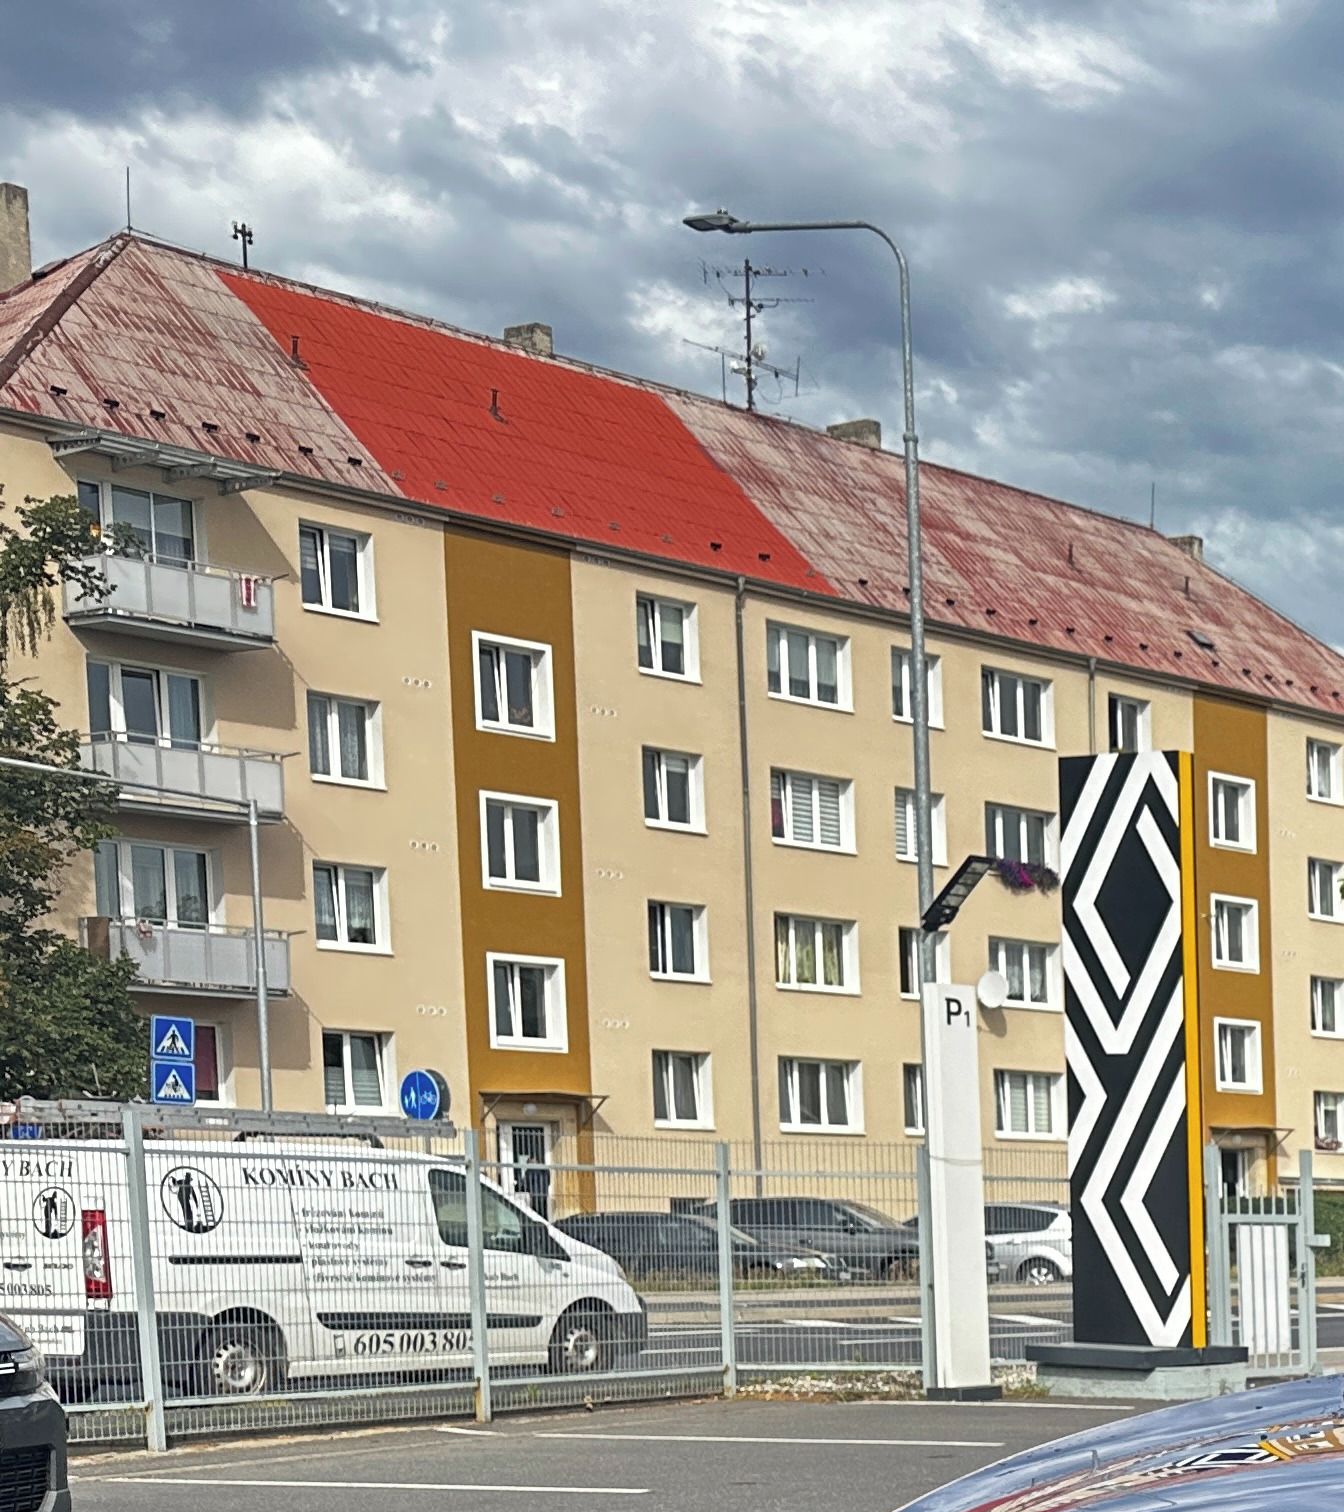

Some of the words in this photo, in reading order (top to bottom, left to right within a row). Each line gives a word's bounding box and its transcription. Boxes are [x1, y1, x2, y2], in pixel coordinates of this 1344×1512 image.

[341, 1171, 398, 1190] BACH
[354, 1333, 395, 1355] 605
[400, 1331, 437, 1353] 003
